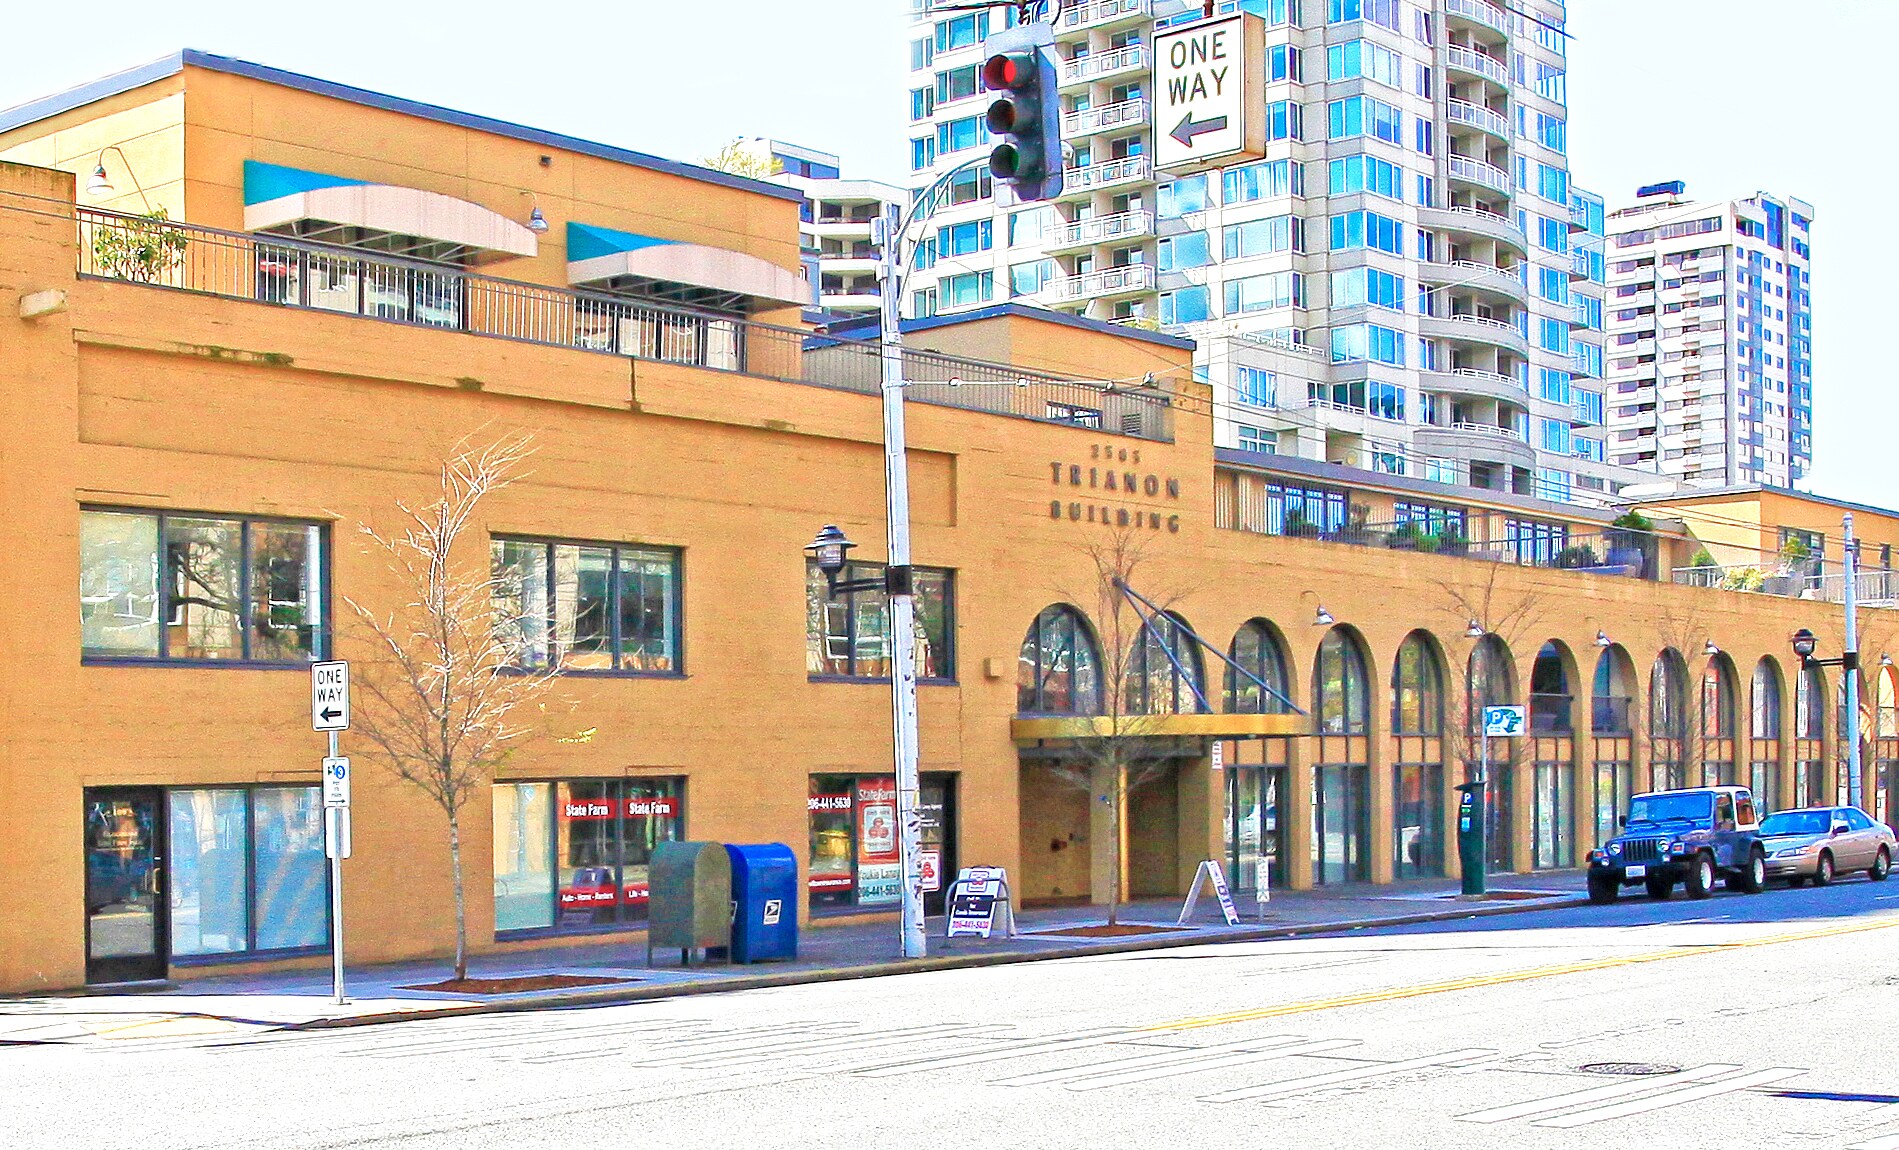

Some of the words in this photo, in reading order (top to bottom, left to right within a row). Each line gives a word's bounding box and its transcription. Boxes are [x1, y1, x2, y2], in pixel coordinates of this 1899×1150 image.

[1171, 30, 1227, 69] ONE
[1168, 65, 1229, 106] WAY
[1091, 443, 1141, 464] 2505
[1050, 461, 1179, 498] TRIANON
[1051, 500, 1180, 533] BUILDING
[318, 669, 342, 685] ONE
[317, 686, 343, 703] WAY
[1491, 711, 1501, 723] P
[858, 789, 878, 802] State
[878, 788, 896, 800] Farm
[1464, 792, 1471, 803] P
[565, 803, 587, 816] State
[588, 803, 609, 815] Farm
[629, 802, 650, 815] State
[651, 801, 671, 814] Farm
